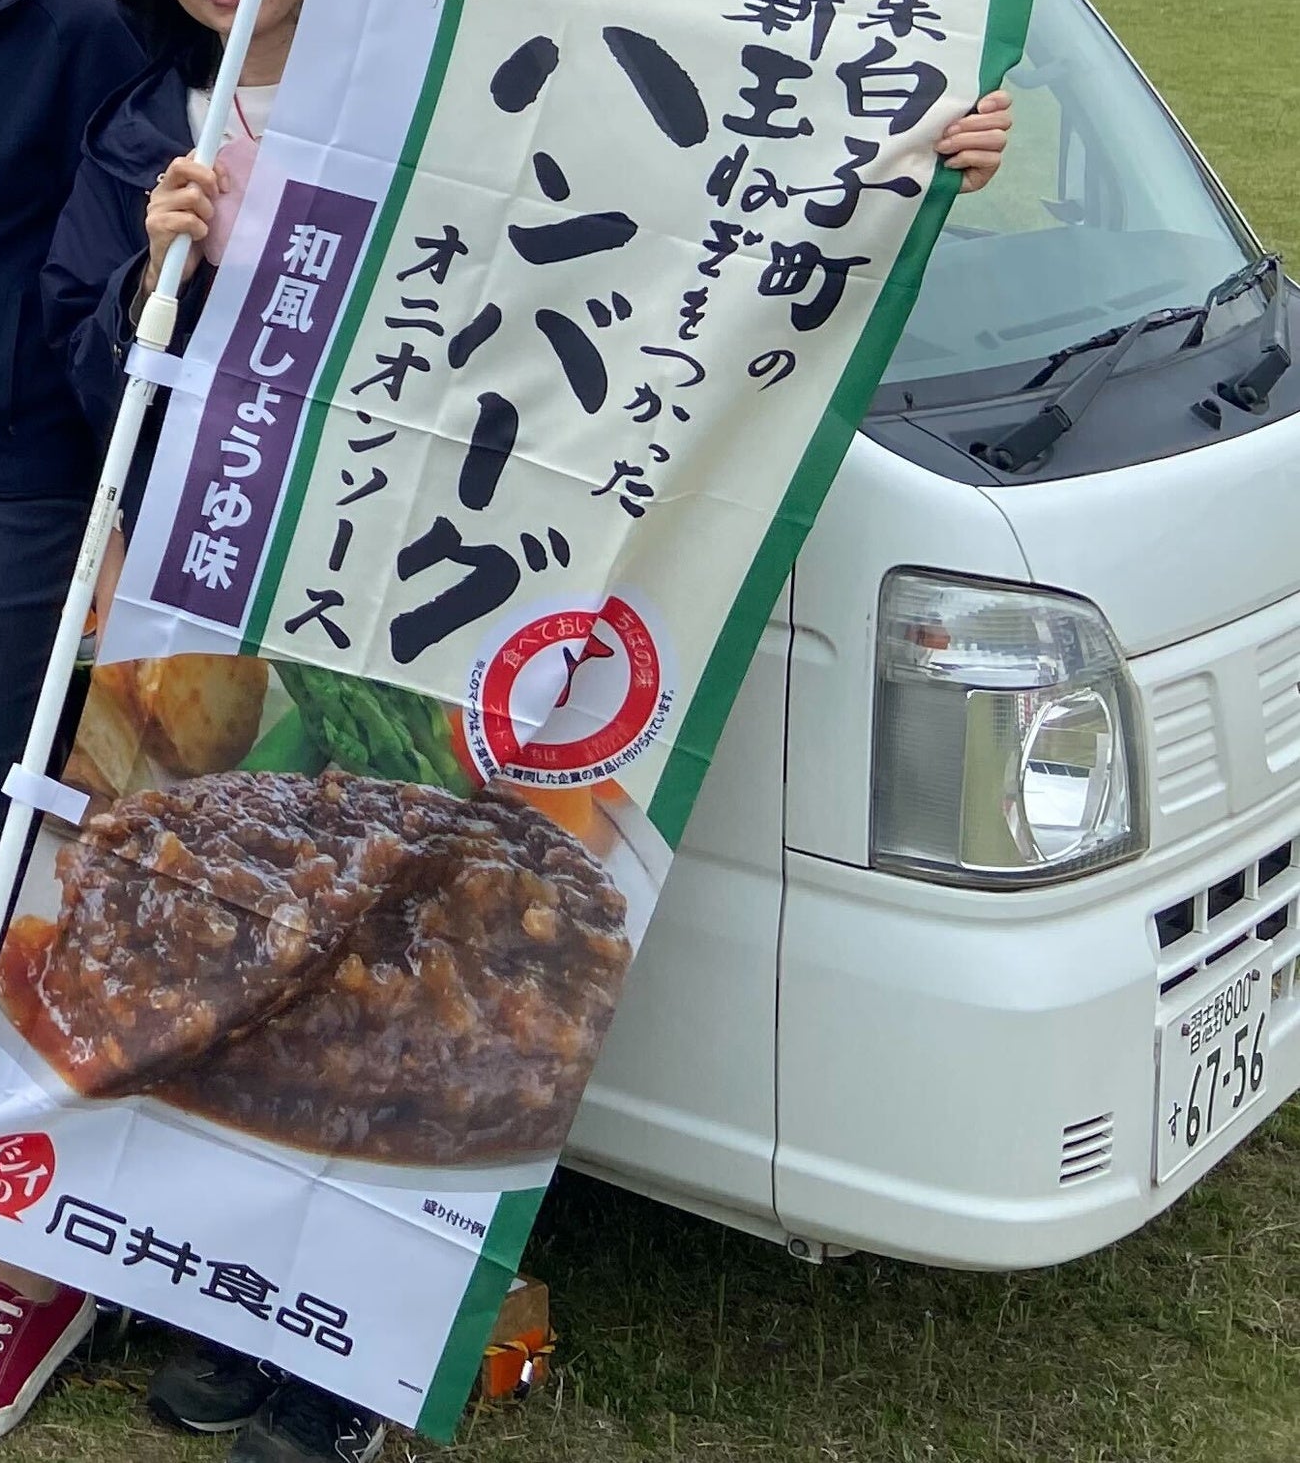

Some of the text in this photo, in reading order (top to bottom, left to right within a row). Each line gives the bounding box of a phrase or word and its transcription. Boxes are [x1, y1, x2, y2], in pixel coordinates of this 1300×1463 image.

[181, 224, 342, 591] 和風しょうゆ味
[390, 26, 710, 664] ハンバーグ
[284, 225, 469, 649] オニオンソース
[1186, 1012, 1265, 1147] 67-56
[1225, 971, 1252, 1027] 800
[45, 1194, 354, 1357] 石井食品
[422, 1198, 486, 1238] 盛り付け例
